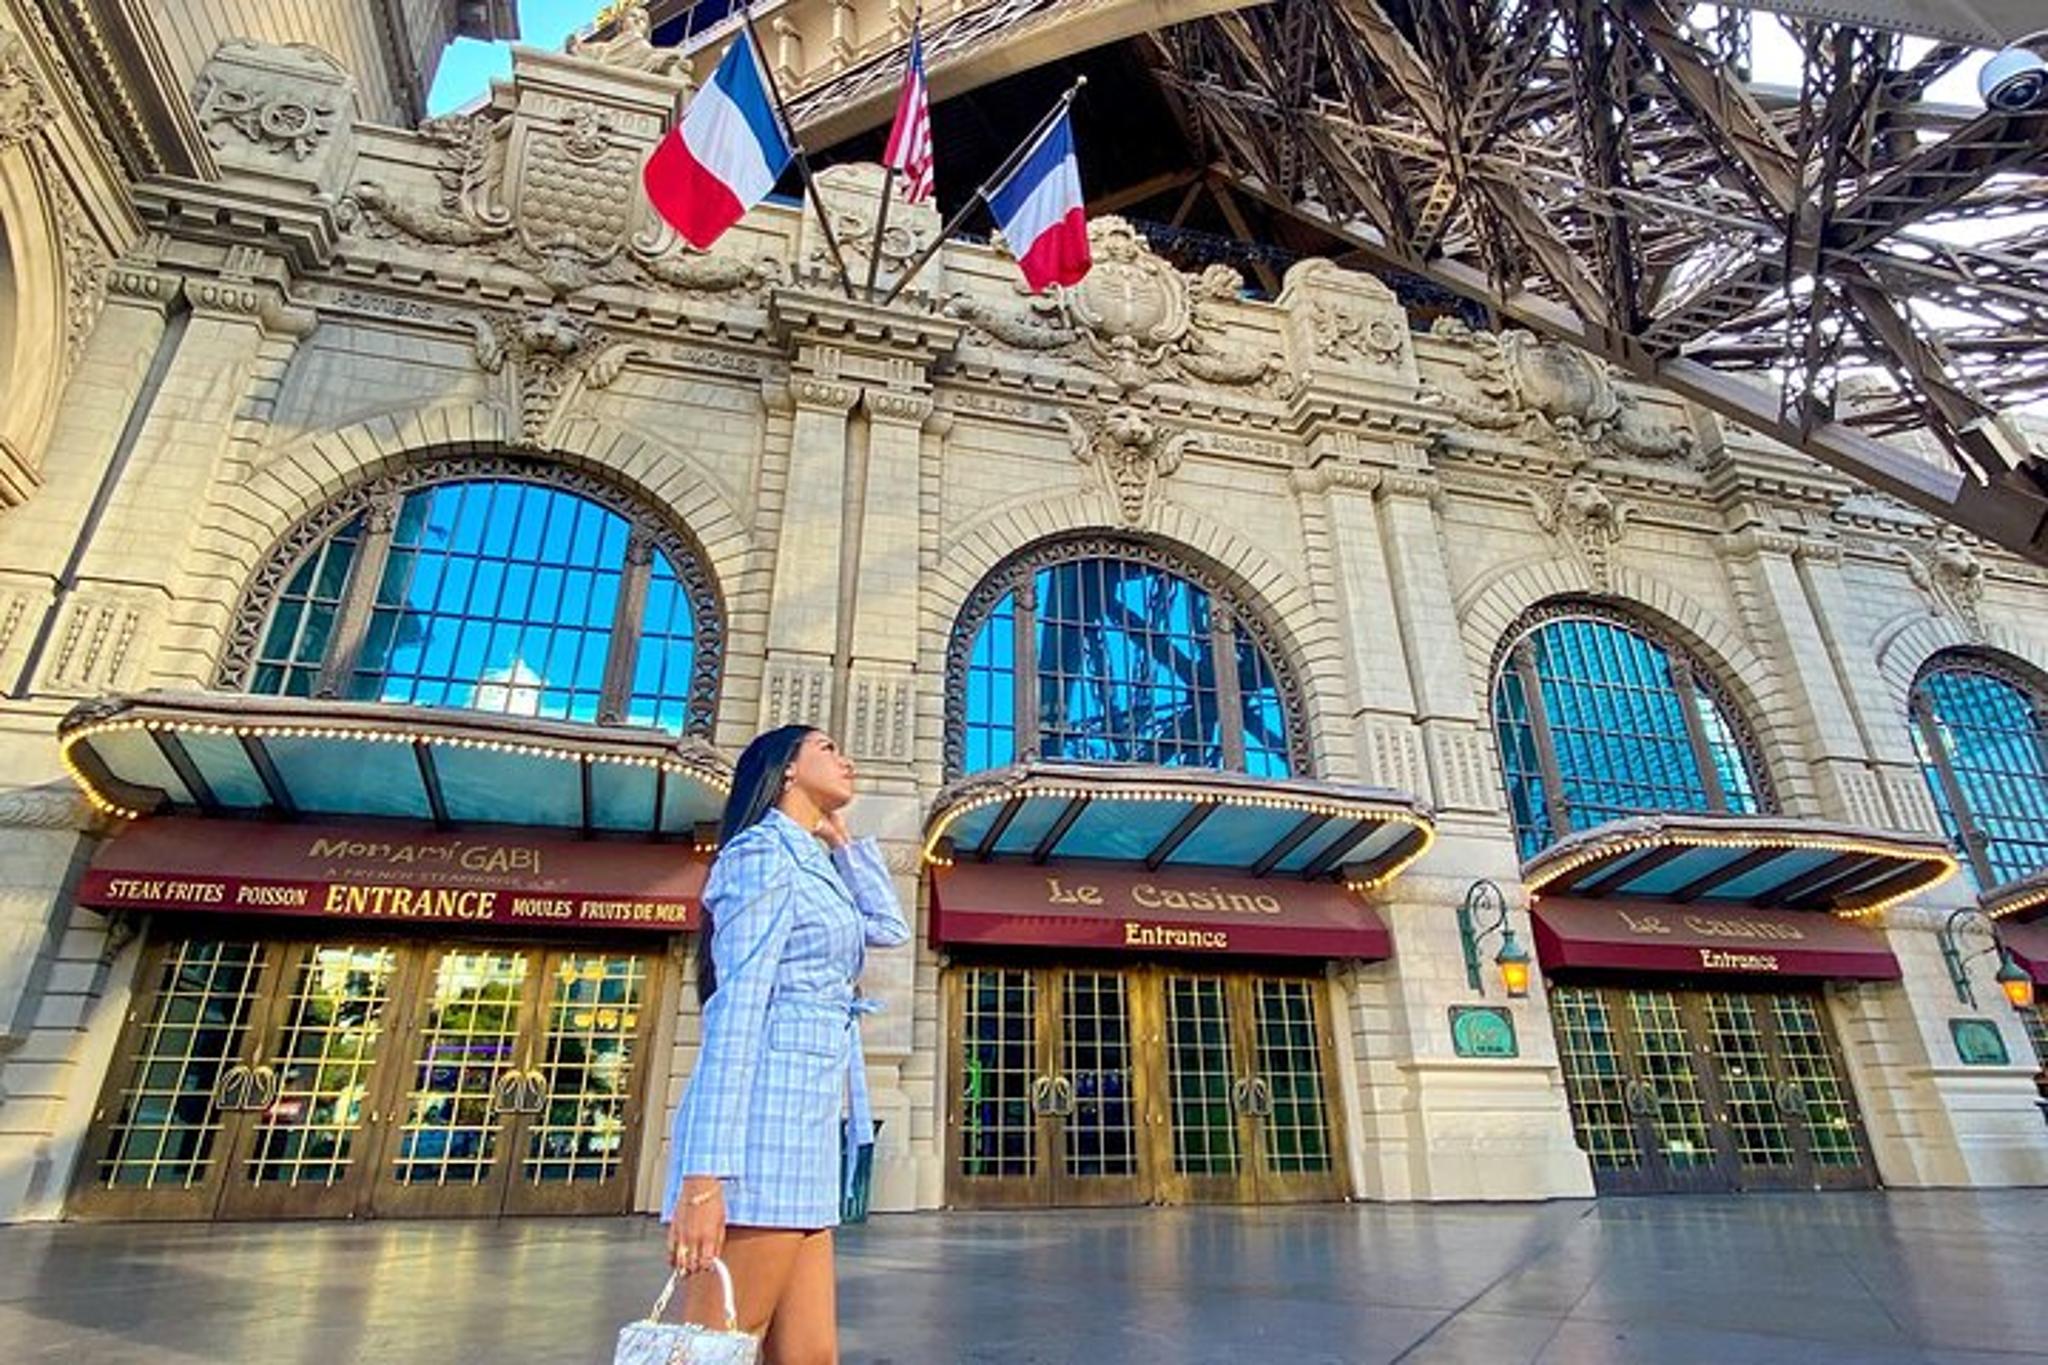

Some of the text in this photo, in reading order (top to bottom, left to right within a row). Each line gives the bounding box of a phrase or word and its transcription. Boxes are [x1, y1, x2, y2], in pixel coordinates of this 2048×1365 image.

[460, 845, 541, 875] GABI
[107, 879, 688, 923] STEAK FRITES POISSON ENTRANCE MOULES FRUITS DE MER
[1046, 877, 1282, 914] Le Casino
[1124, 922, 1229, 949] Entrance
[1616, 908, 1805, 940] Le Casino
[1699, 948, 1779, 971] Entrance
